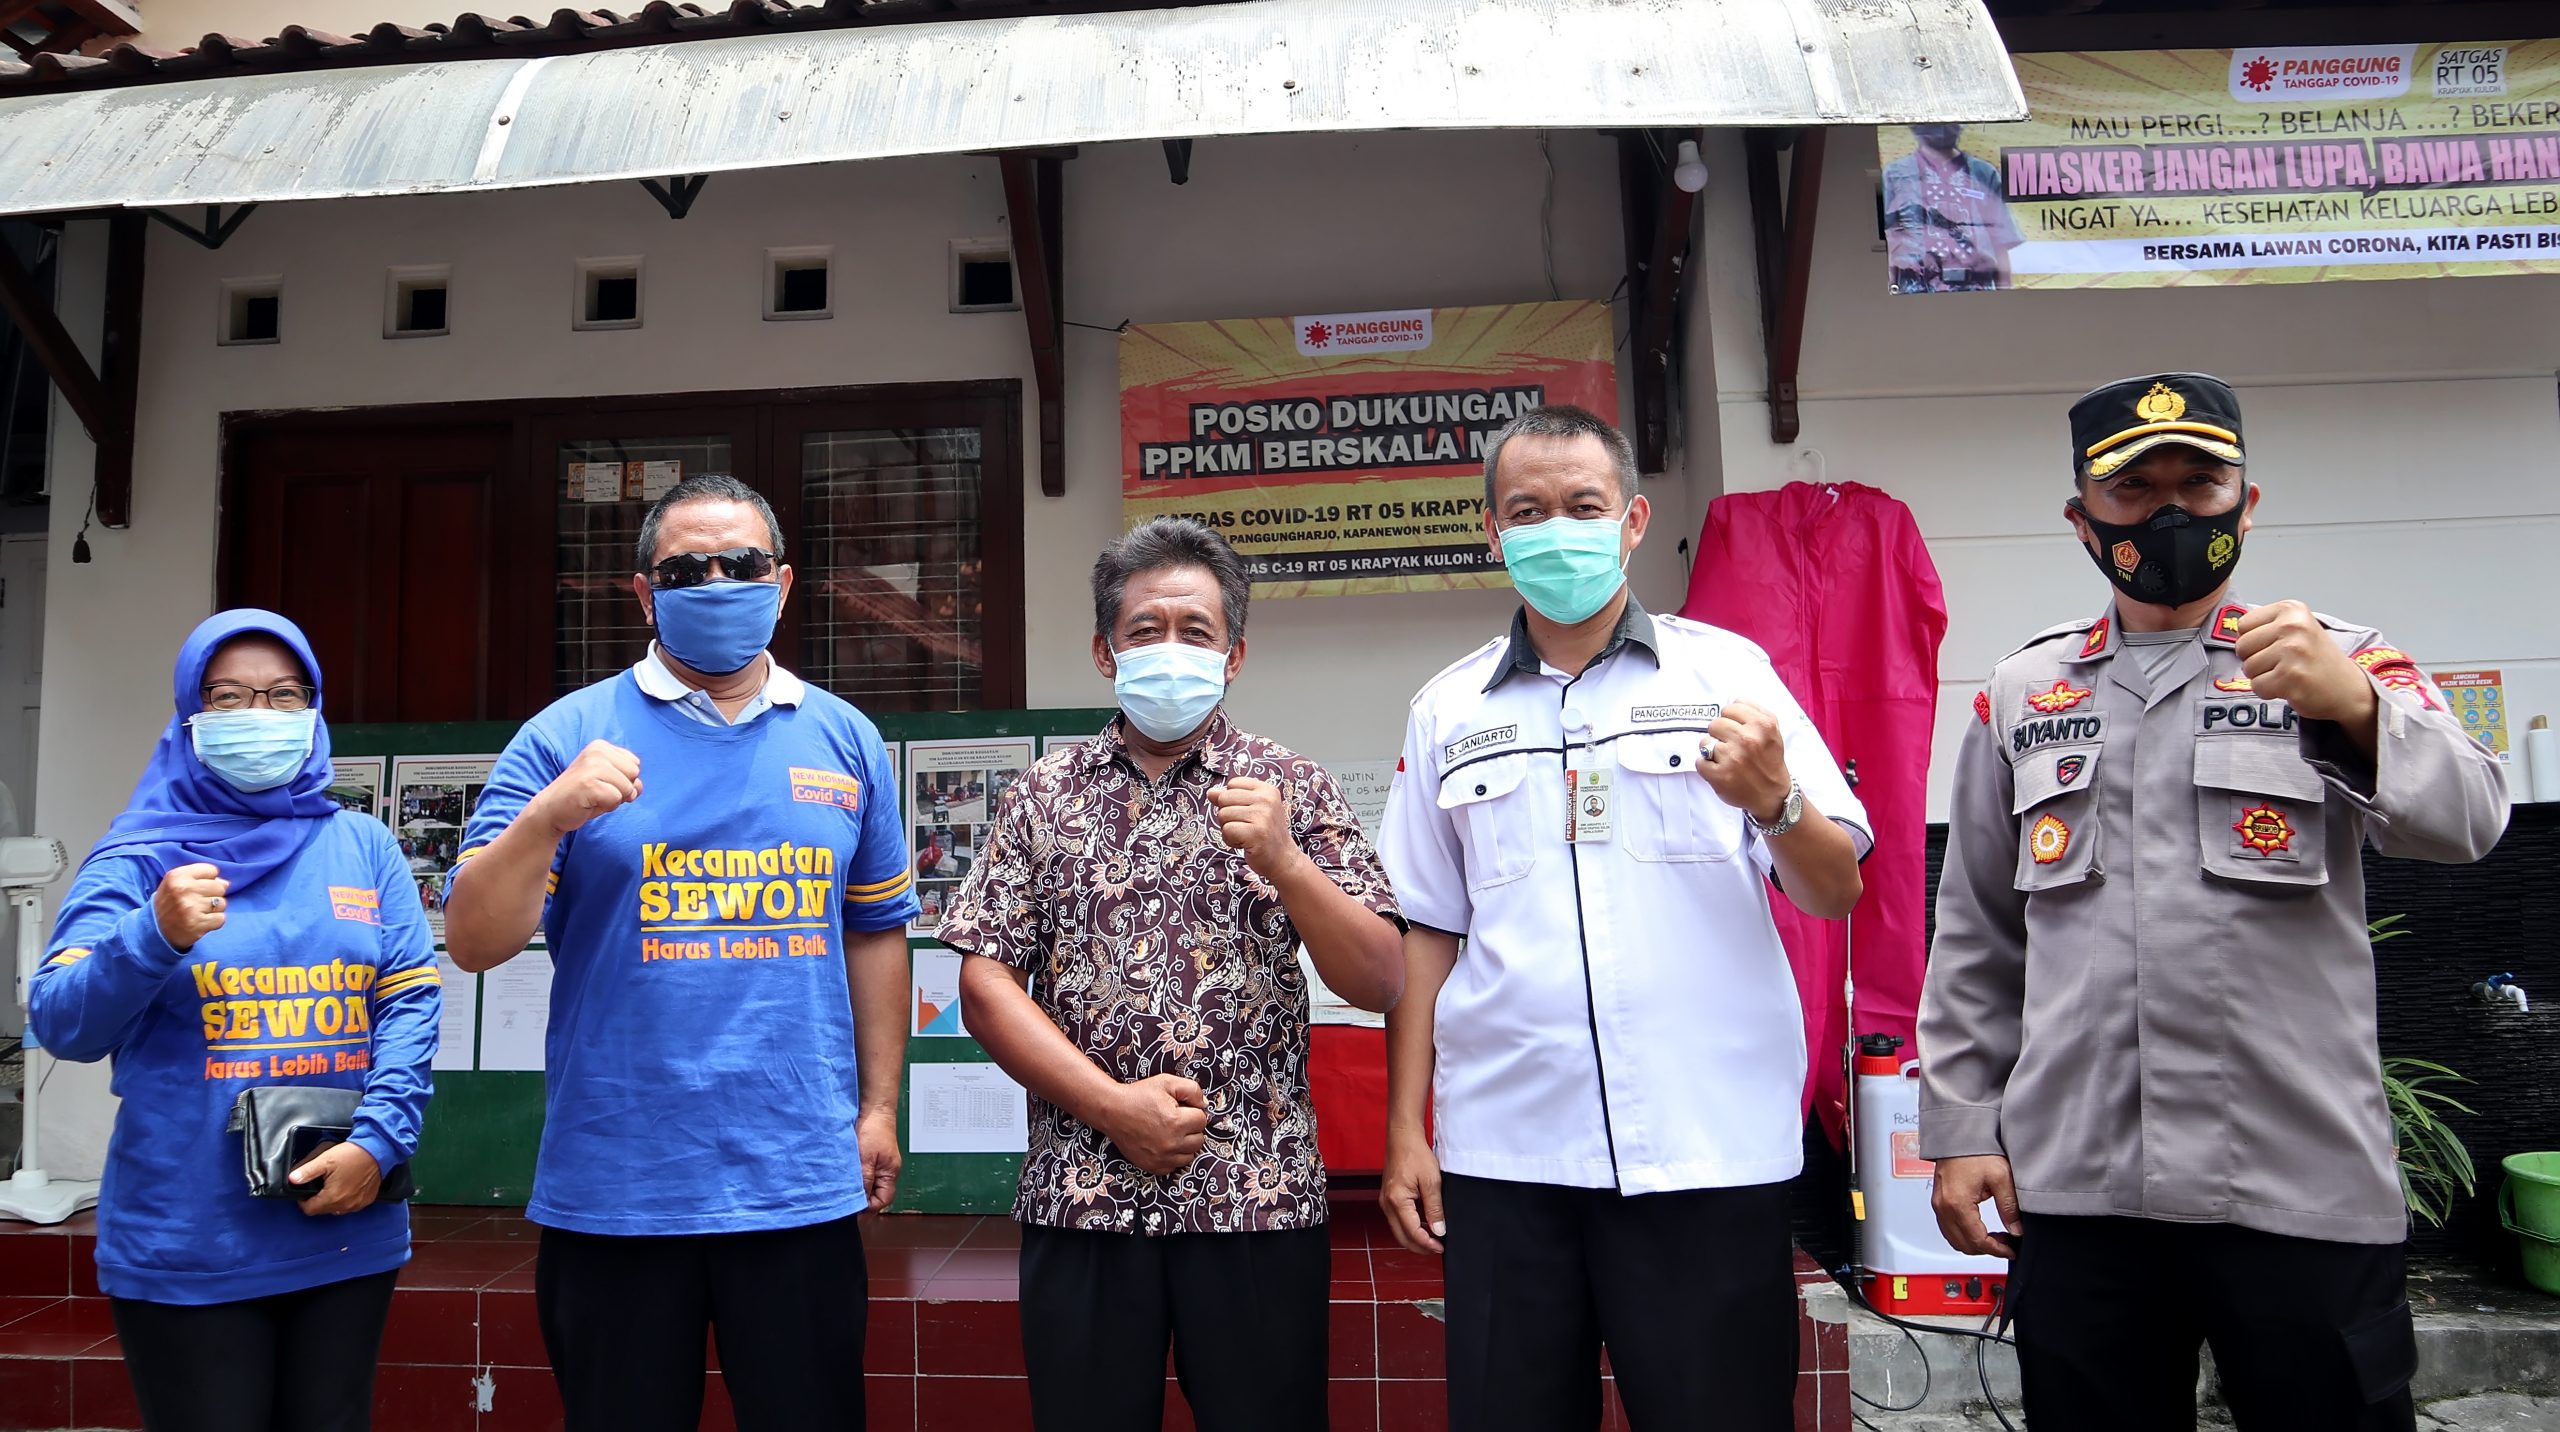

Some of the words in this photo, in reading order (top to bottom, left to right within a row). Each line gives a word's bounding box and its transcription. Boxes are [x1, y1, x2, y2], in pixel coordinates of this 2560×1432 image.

[2283, 56, 2400, 75] PANGGUNG
[2438, 49, 2501, 65] SATGAS
[2283, 77, 2339, 89] TANGGAP
[2343, 75, 2399, 87] COVID-19
[2437, 67, 2465, 85] RT
[2471, 65, 2499, 84] 05
[2437, 87, 2472, 95] KRAPYAK
[2071, 117, 2130, 139] MAU
[2281, 108, 2407, 134] BELANJA
[2471, 101, 2560, 127] BEKER
[2008, 150, 2144, 196] MASKER
[2153, 146, 2278, 192] JANGAN
[2284, 144, 2376, 189] LUPA,
[2380, 141, 2485, 184] BAWA
[2488, 137, 2560, 181] HAN
[2041, 206, 2120, 231] INGAT
[2128, 205, 2192, 227] YA...
[2202, 200, 2350, 225] KESEHATAN
[2360, 195, 2503, 220] KELUARGA
[2510, 192, 2558, 214] LEB
[2144, 242, 2244, 261] BERSAMA
[2252, 240, 2322, 257] LAWAN
[2328, 237, 2421, 255] CORONA,
[2427, 235, 2470, 251] KITA
[2476, 234, 2531, 250] PASTI
[1335, 319, 1423, 336] PANGGUNG
[1337, 336, 1379, 346] TANGGAP
[1381, 333, 1423, 343] COVID-19
[1195, 402, 1320, 436] POSKO
[1331, 391, 1540, 428] DUKUNGAN
[1145, 443, 1250, 475] PPKM
[1263, 432, 1459, 469] BERSKALA
[1241, 506, 1339, 526] COVID-19
[1347, 504, 1372, 521] RT
[1378, 503, 1405, 519] 05
[1411, 498, 1486, 517] KRAPY
[1230, 530, 1340, 544] PANGGUNGHARJO,
[1343, 525, 1420, 539] KAPANEWON
[1424, 523, 1472, 534] SEWON,
[1272, 561, 1303, 573] C-19
[1308, 560, 1326, 572] RT
[1329, 559, 1347, 571] 05
[1352, 555, 1420, 570] KRAPYAK
[1424, 553, 1473, 567] KULON
[2212, 552, 2233, 571] POLRI
[2116, 568, 2132, 582] TNI
[1635, 706, 1717, 719] PANGGUNGHARJO
[2203, 703, 2299, 730] POLR
[1448, 747, 1458, 758] S.
[1458, 728, 1514, 753] JANUARTO
[2013, 715, 2101, 751] SUYANTO
[793, 772, 815, 780] NEW
[817, 774, 856, 788] NORMAL
[1341, 772, 1374, 782] RUTIN
[795, 786, 833, 802] Covid
[836, 792, 856, 808] -19
[1356, 786, 1370, 795] 05
[641, 841, 833, 878] Kecamatan
[639, 879, 832, 922] SEWON
[336, 904, 371, 921] Covid
[642, 938, 711, 963] Harus
[719, 937, 779, 960] Lebih
[788, 935, 827, 957] Baik
[191, 958, 376, 998] Kecamatan
[201, 996, 368, 1040] SEWON
[270, 1053, 330, 1077] Lebih
